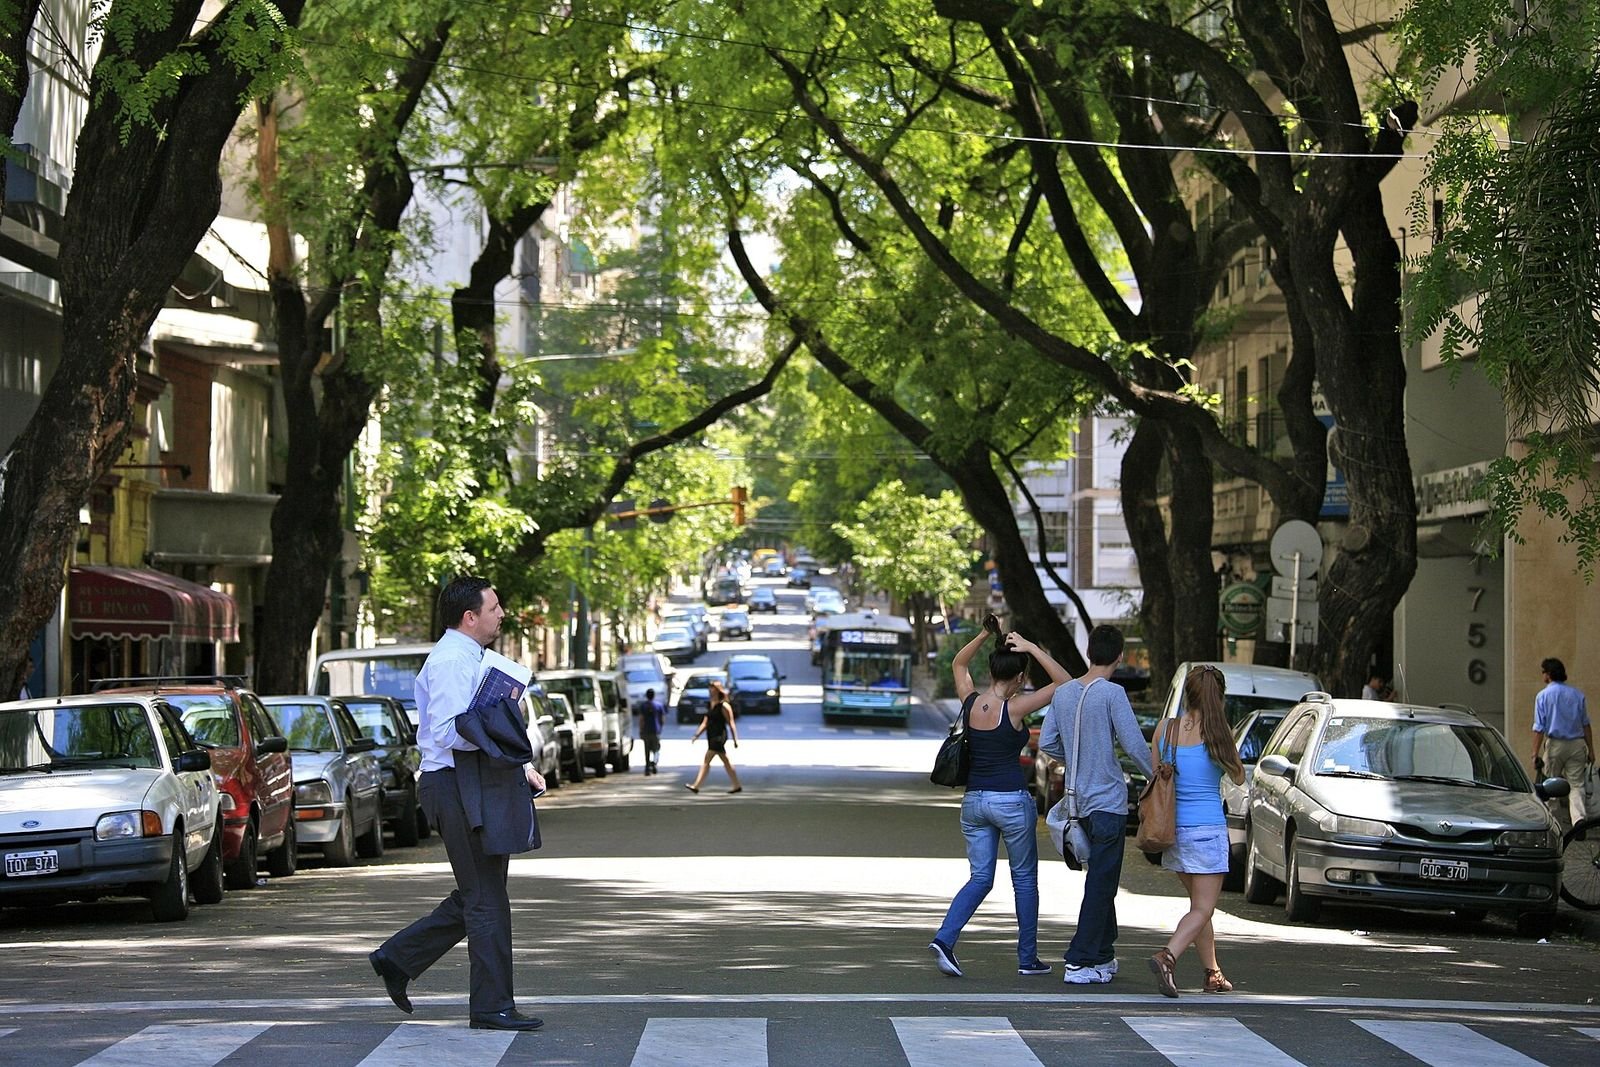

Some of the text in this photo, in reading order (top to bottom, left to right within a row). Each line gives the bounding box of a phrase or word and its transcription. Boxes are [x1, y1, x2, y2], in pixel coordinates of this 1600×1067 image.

[79, 600, 95, 615] EL
[841, 630, 862, 643] 92
[8, 856, 57, 873] TOY 971
[1447, 866, 1467, 880] 370
